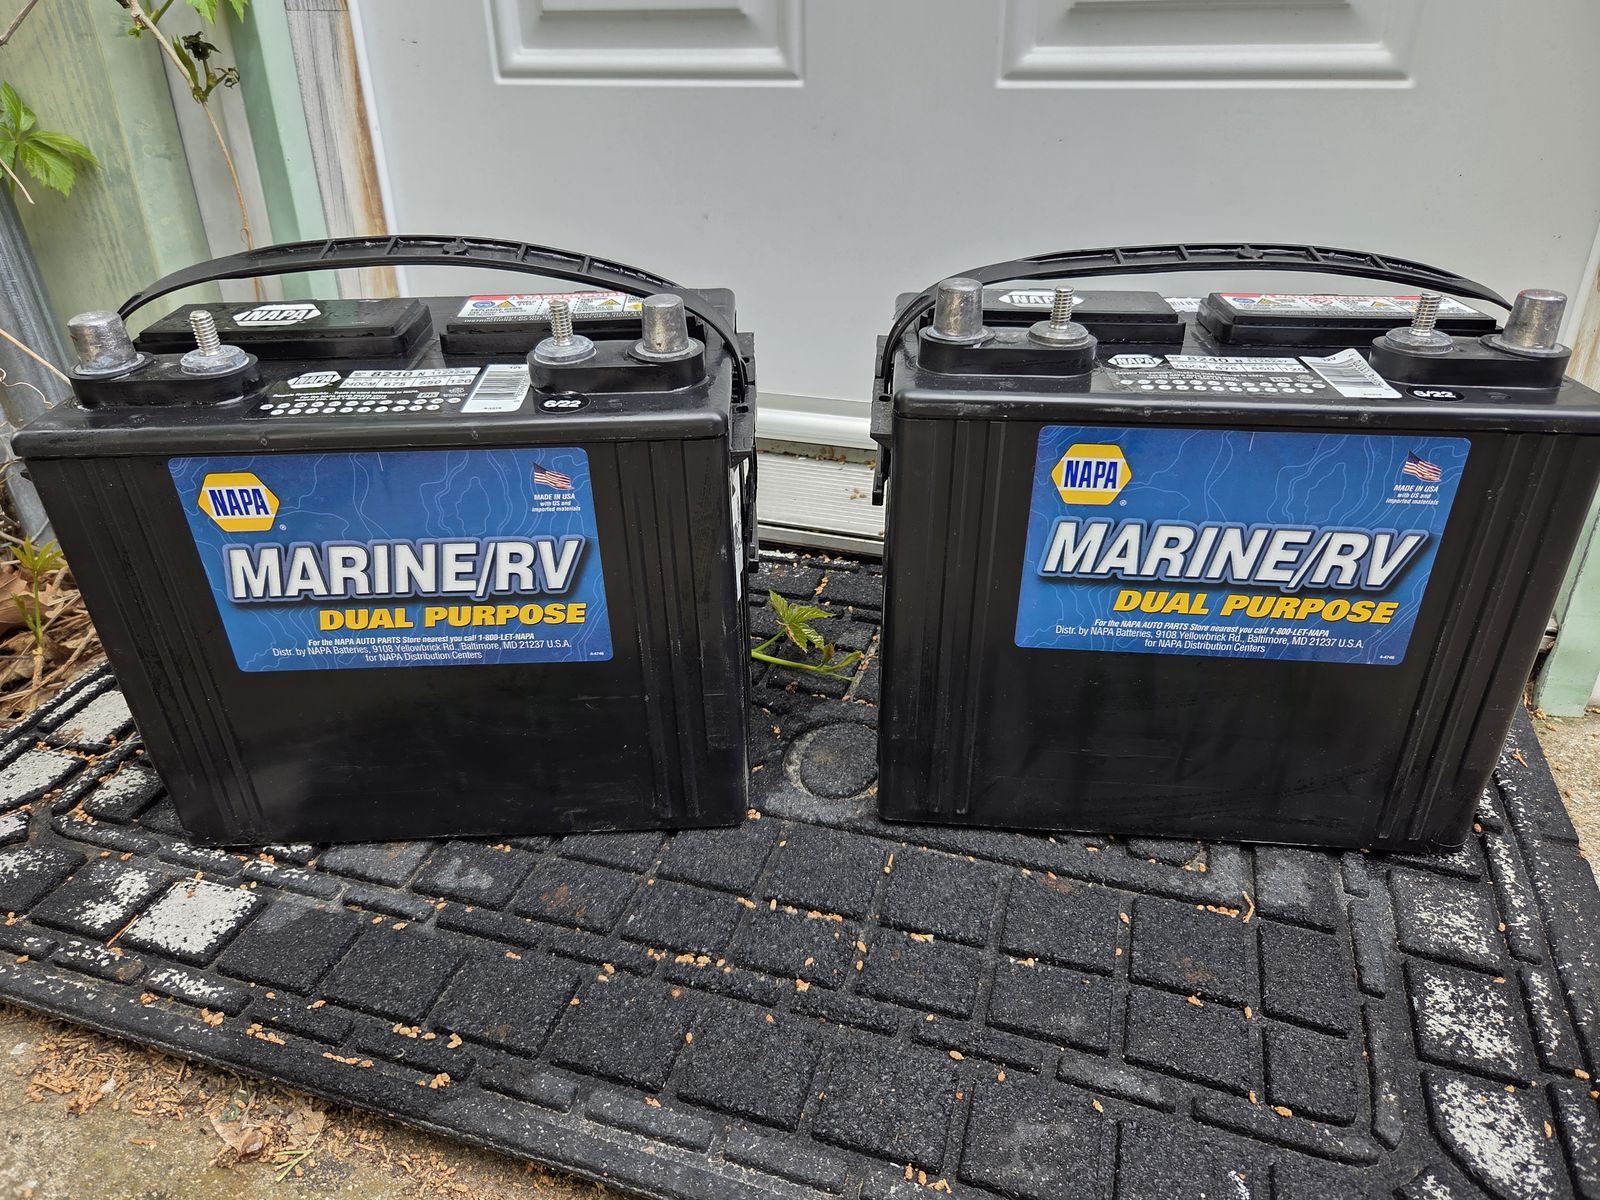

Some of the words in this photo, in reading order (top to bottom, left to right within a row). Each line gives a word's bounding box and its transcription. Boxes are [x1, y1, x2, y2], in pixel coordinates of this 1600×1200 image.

[1012, 295, 1056, 304] NAP
[246, 309, 309, 321] NAPA
[295, 375, 334, 385] NAPA
[1414, 390, 1456, 399] 6/22
[543, 400, 581, 408] 6/22
[1064, 460, 1118, 489] NAPA
[208, 488, 270, 517] NAPA
[1041, 519, 1425, 588] MARINE/RV
[226, 538, 583, 599] MARINE/RV
[1113, 589, 1210, 615] DUAL
[1219, 594, 1399, 624] PURPOSE
[319, 608, 414, 631] DUAL
[424, 602, 587, 628] PURPOSE
[1056, 625, 1076, 634] Distr.
[1078, 626, 1088, 636] by
[1090, 627, 1114, 636] NAPA
[1116, 628, 1153, 639] Batteries,
[1156, 630, 1177, 639] 9108
[1179, 631, 1226, 642] Yellowbrick
[1247, 634, 1290, 646] Baltimore,
[1292, 637, 1307, 646] MD
[1309, 638, 1337, 647] 21237
[1338, 639, 1364, 648] U.S.A.
[1110, 619, 1119, 627] the
[1120, 620, 1141, 628] NAPA
[1142, 621, 1163, 629] AUTO
[1164, 622, 1188, 631] PARTS
[1210, 625, 1239, 633] nearest
[1239, 627, 1253, 635] you
[1270, 628, 1329, 637] 1-800-LET-NAPA
[272, 648, 294, 657] Distr.
[296, 648, 306, 657] by
[308, 647, 330, 656] NAPA
[334, 645, 371, 655] Batteries,
[373, 644, 393, 653] 9108
[394, 643, 441, 653] Yellowbrick
[462, 641, 501, 650] Baltimore,
[504, 640, 518, 649] MD
[520, 640, 544, 649] 21237
[547, 639, 572, 648] U.S.A.
[322, 638, 332, 646] the
[334, 637, 354, 645] NAPA
[356, 636, 375, 645] AUTO
[378, 636, 401, 644] PARTS
[422, 634, 449, 642] nearest
[464, 634, 476, 642] call
[478, 632, 534, 641] 1-800-LET-NAPA
[1144, 639, 1157, 648] for
[1158, 640, 1182, 649] NAPA
[1184, 640, 1232, 651] Distribution
[1234, 643, 1266, 653] Centers
[366, 654, 378, 662] for
[379, 652, 401, 661] NAPA
[405, 652, 450, 661] Distribution
[452, 650, 483, 660] Centers
